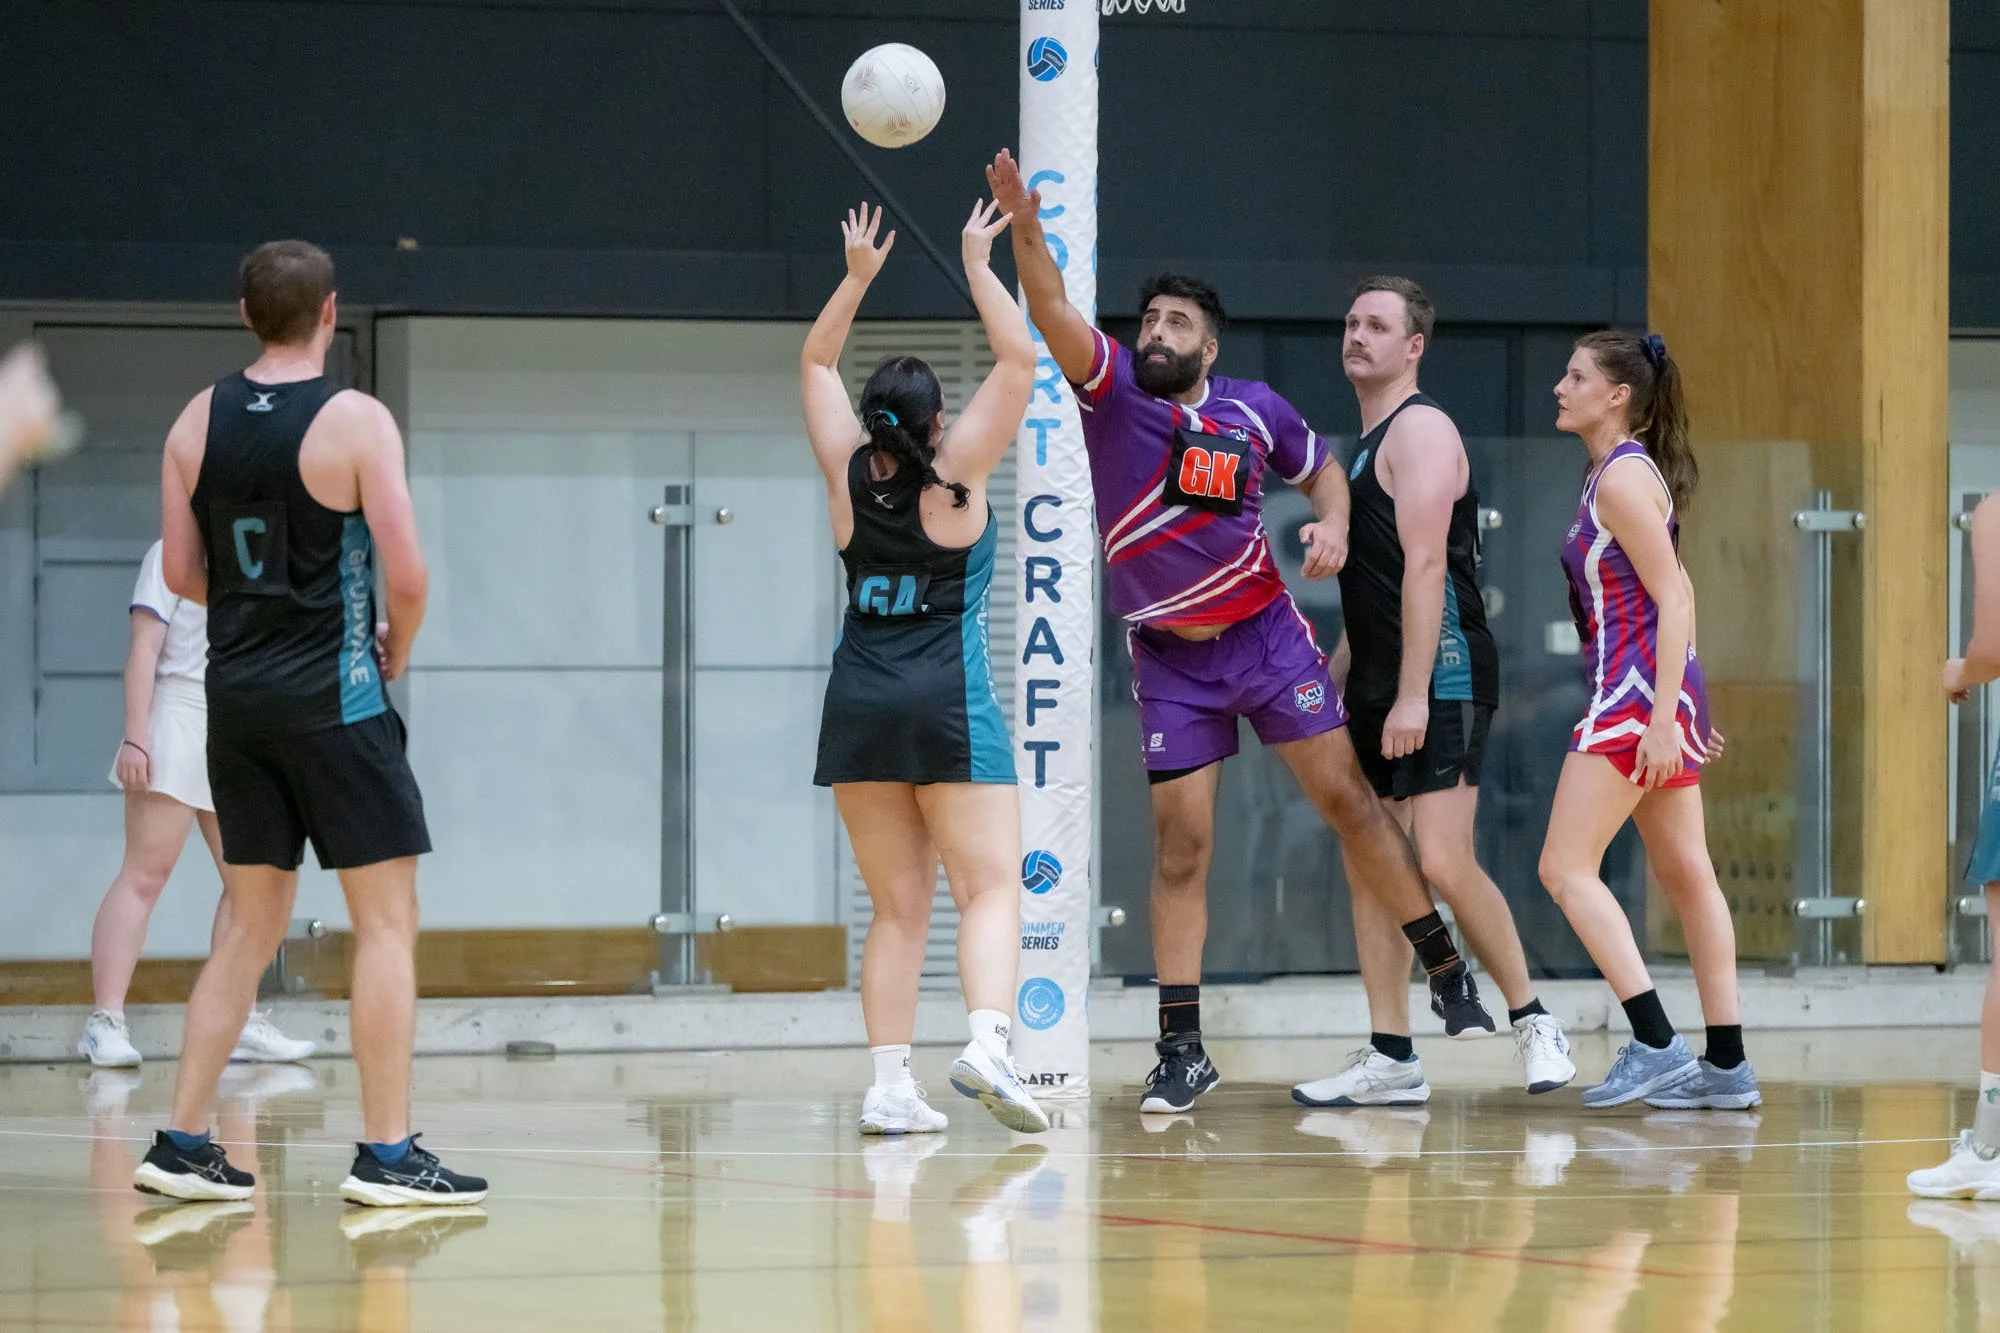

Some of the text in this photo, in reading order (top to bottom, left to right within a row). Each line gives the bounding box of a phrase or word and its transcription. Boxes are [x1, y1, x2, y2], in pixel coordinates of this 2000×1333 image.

[1028, 0, 1065, 10] SERIES
[1023, 169, 1069, 789] CRT CRAFT
[1178, 446, 1241, 501] GK
[233, 517, 266, 580] C
[859, 575, 917, 617] GA
[1297, 685, 1323, 705] ACU
[1020, 921, 1065, 935] SUMMER
[1021, 936, 1060, 950] SERIES
